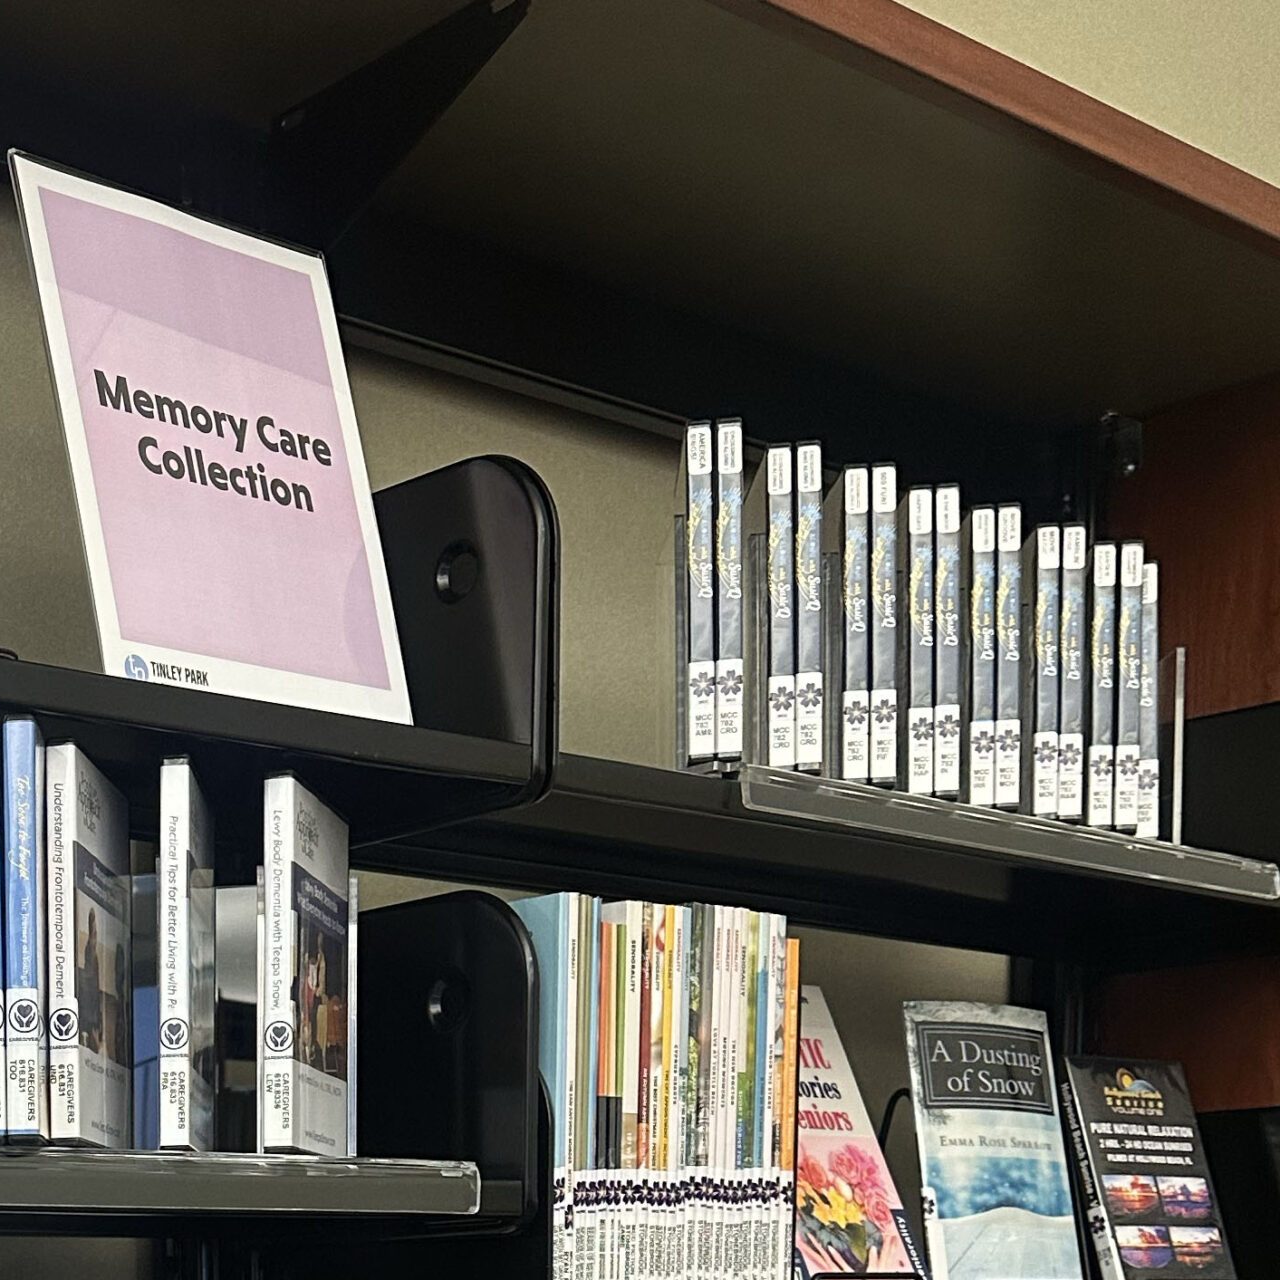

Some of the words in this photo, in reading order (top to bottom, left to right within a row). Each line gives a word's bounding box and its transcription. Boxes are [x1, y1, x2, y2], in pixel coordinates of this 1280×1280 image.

[94, 369, 248, 452] Memory
[256, 417, 332, 467] Care
[137, 436, 315, 513] Collection
[151, 661, 183, 682] TINLEY
[185, 668, 209, 686] PARK
[931, 1041, 952, 1062] A
[961, 1041, 1042, 1076] Dusting
[948, 1069, 974, 1093] of
[979, 1073, 1036, 1096] Snow
